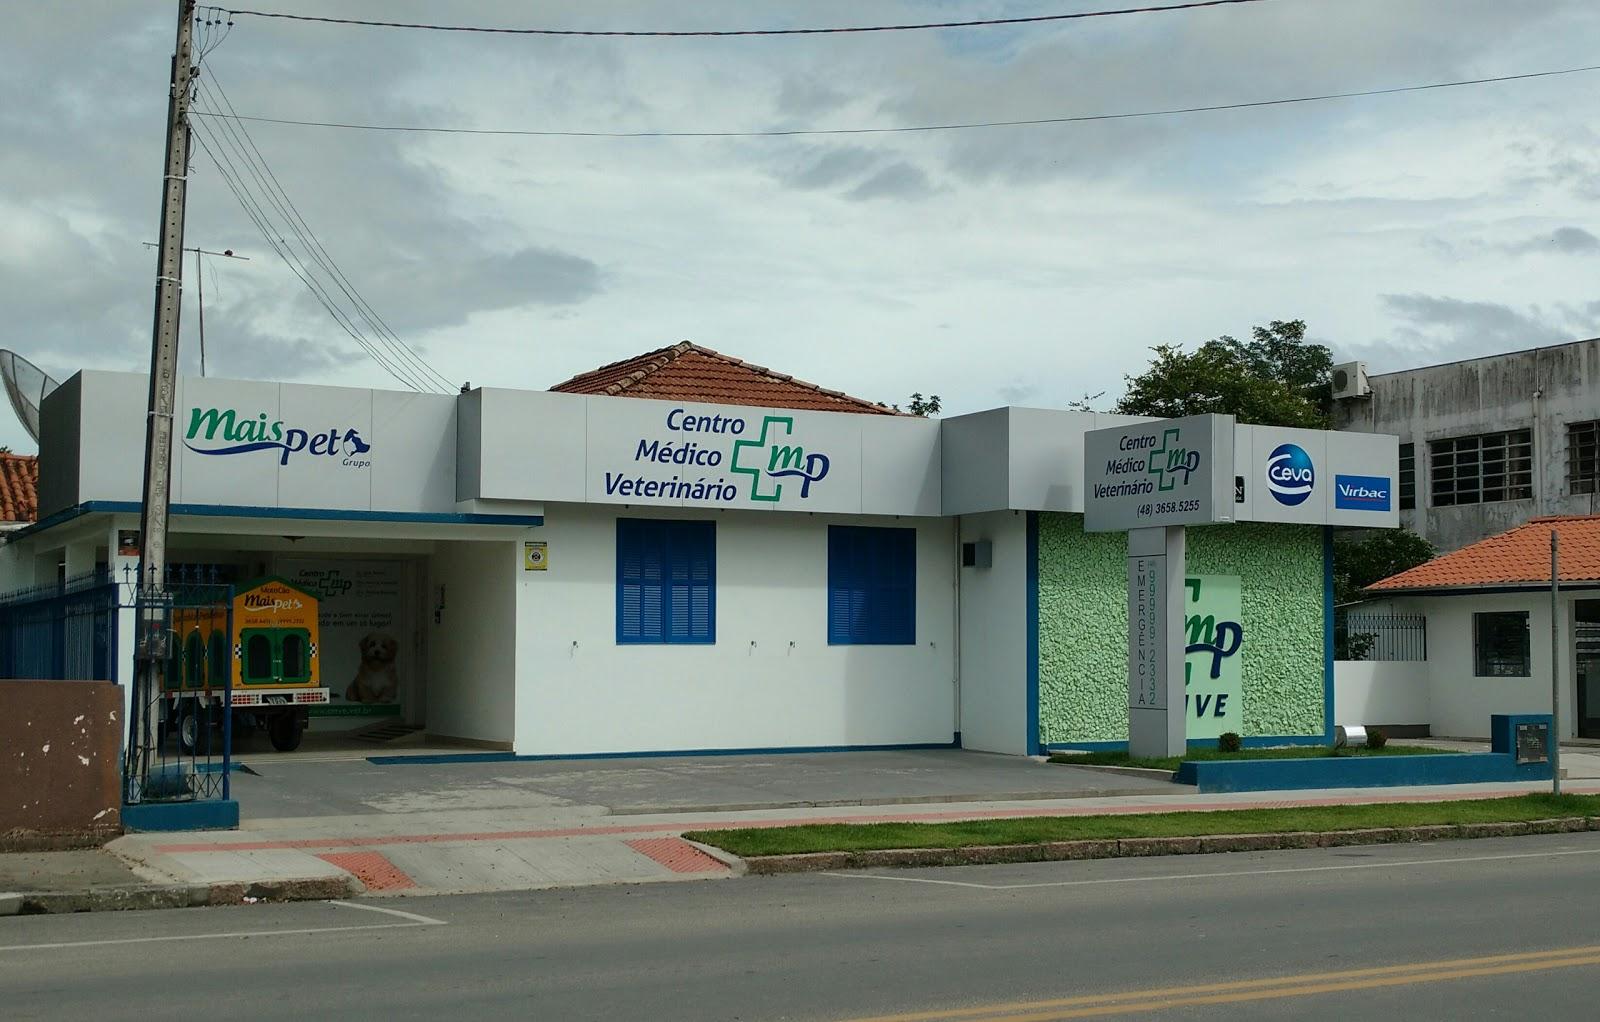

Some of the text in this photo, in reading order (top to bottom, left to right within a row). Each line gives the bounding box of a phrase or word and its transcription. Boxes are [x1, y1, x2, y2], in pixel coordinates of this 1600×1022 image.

[185, 407, 284, 442] Mais
[666, 408, 746, 435] Centro
[634, 439, 723, 467] Médico
[1119, 434, 1157, 452] Centro
[342, 458, 371, 468] Grupo
[1105, 457, 1146, 476] Médico
[605, 472, 738, 502] Veterinário
[1093, 478, 1154, 499] Veterinário
[1338, 483, 1387, 499] Virbac
[1137, 499, 1200, 519] (48) 3658.5255
[1136, 559, 1147, 706] EMERGÊNCIA
